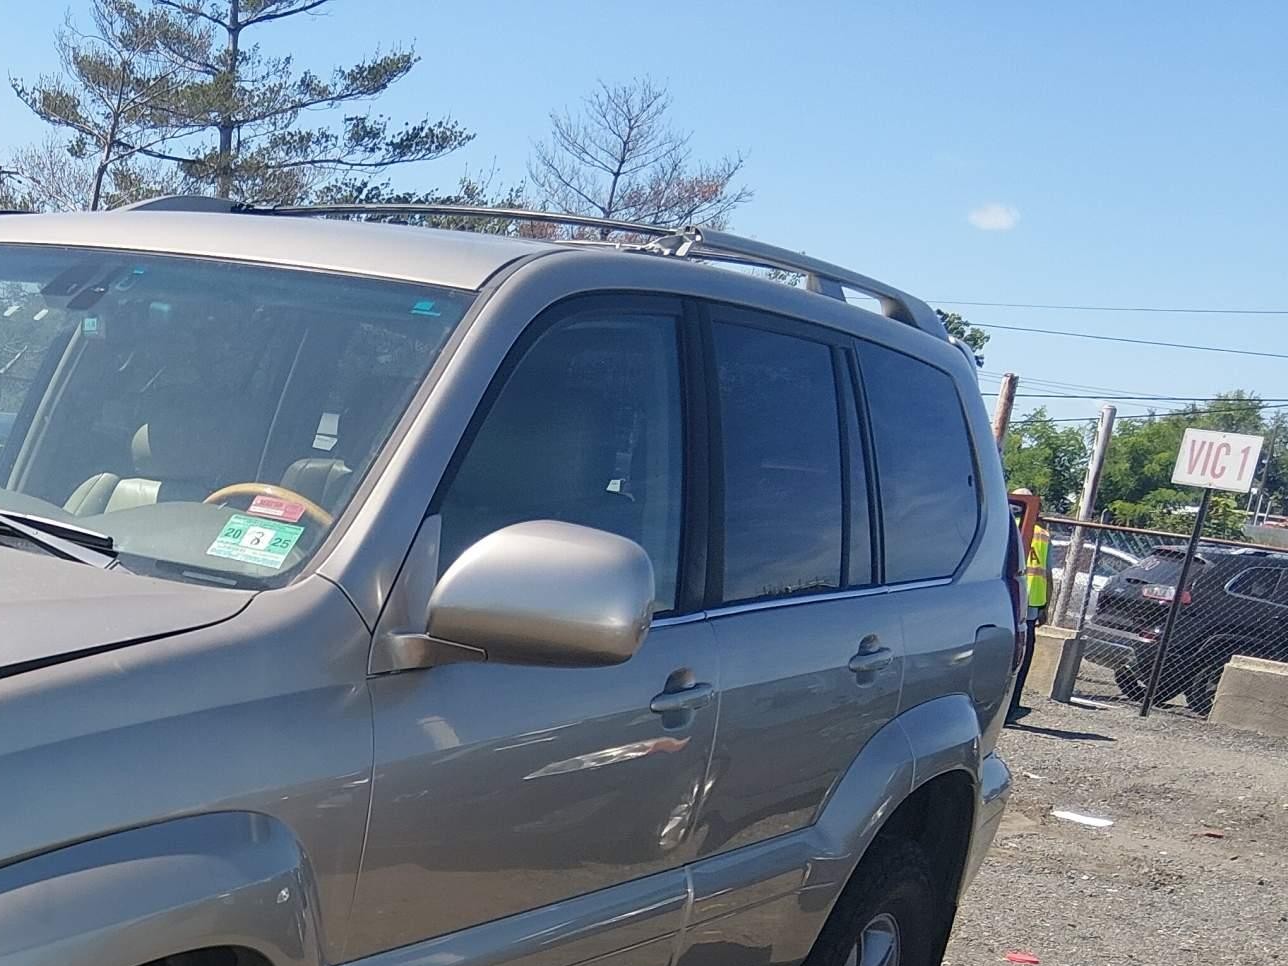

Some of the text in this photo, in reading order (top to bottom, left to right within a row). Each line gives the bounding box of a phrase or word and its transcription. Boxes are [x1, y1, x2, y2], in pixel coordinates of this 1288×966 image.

[1187, 440, 1252, 481] VIC 1
[224, 527, 243, 540] 20
[271, 537, 291, 549] 25
